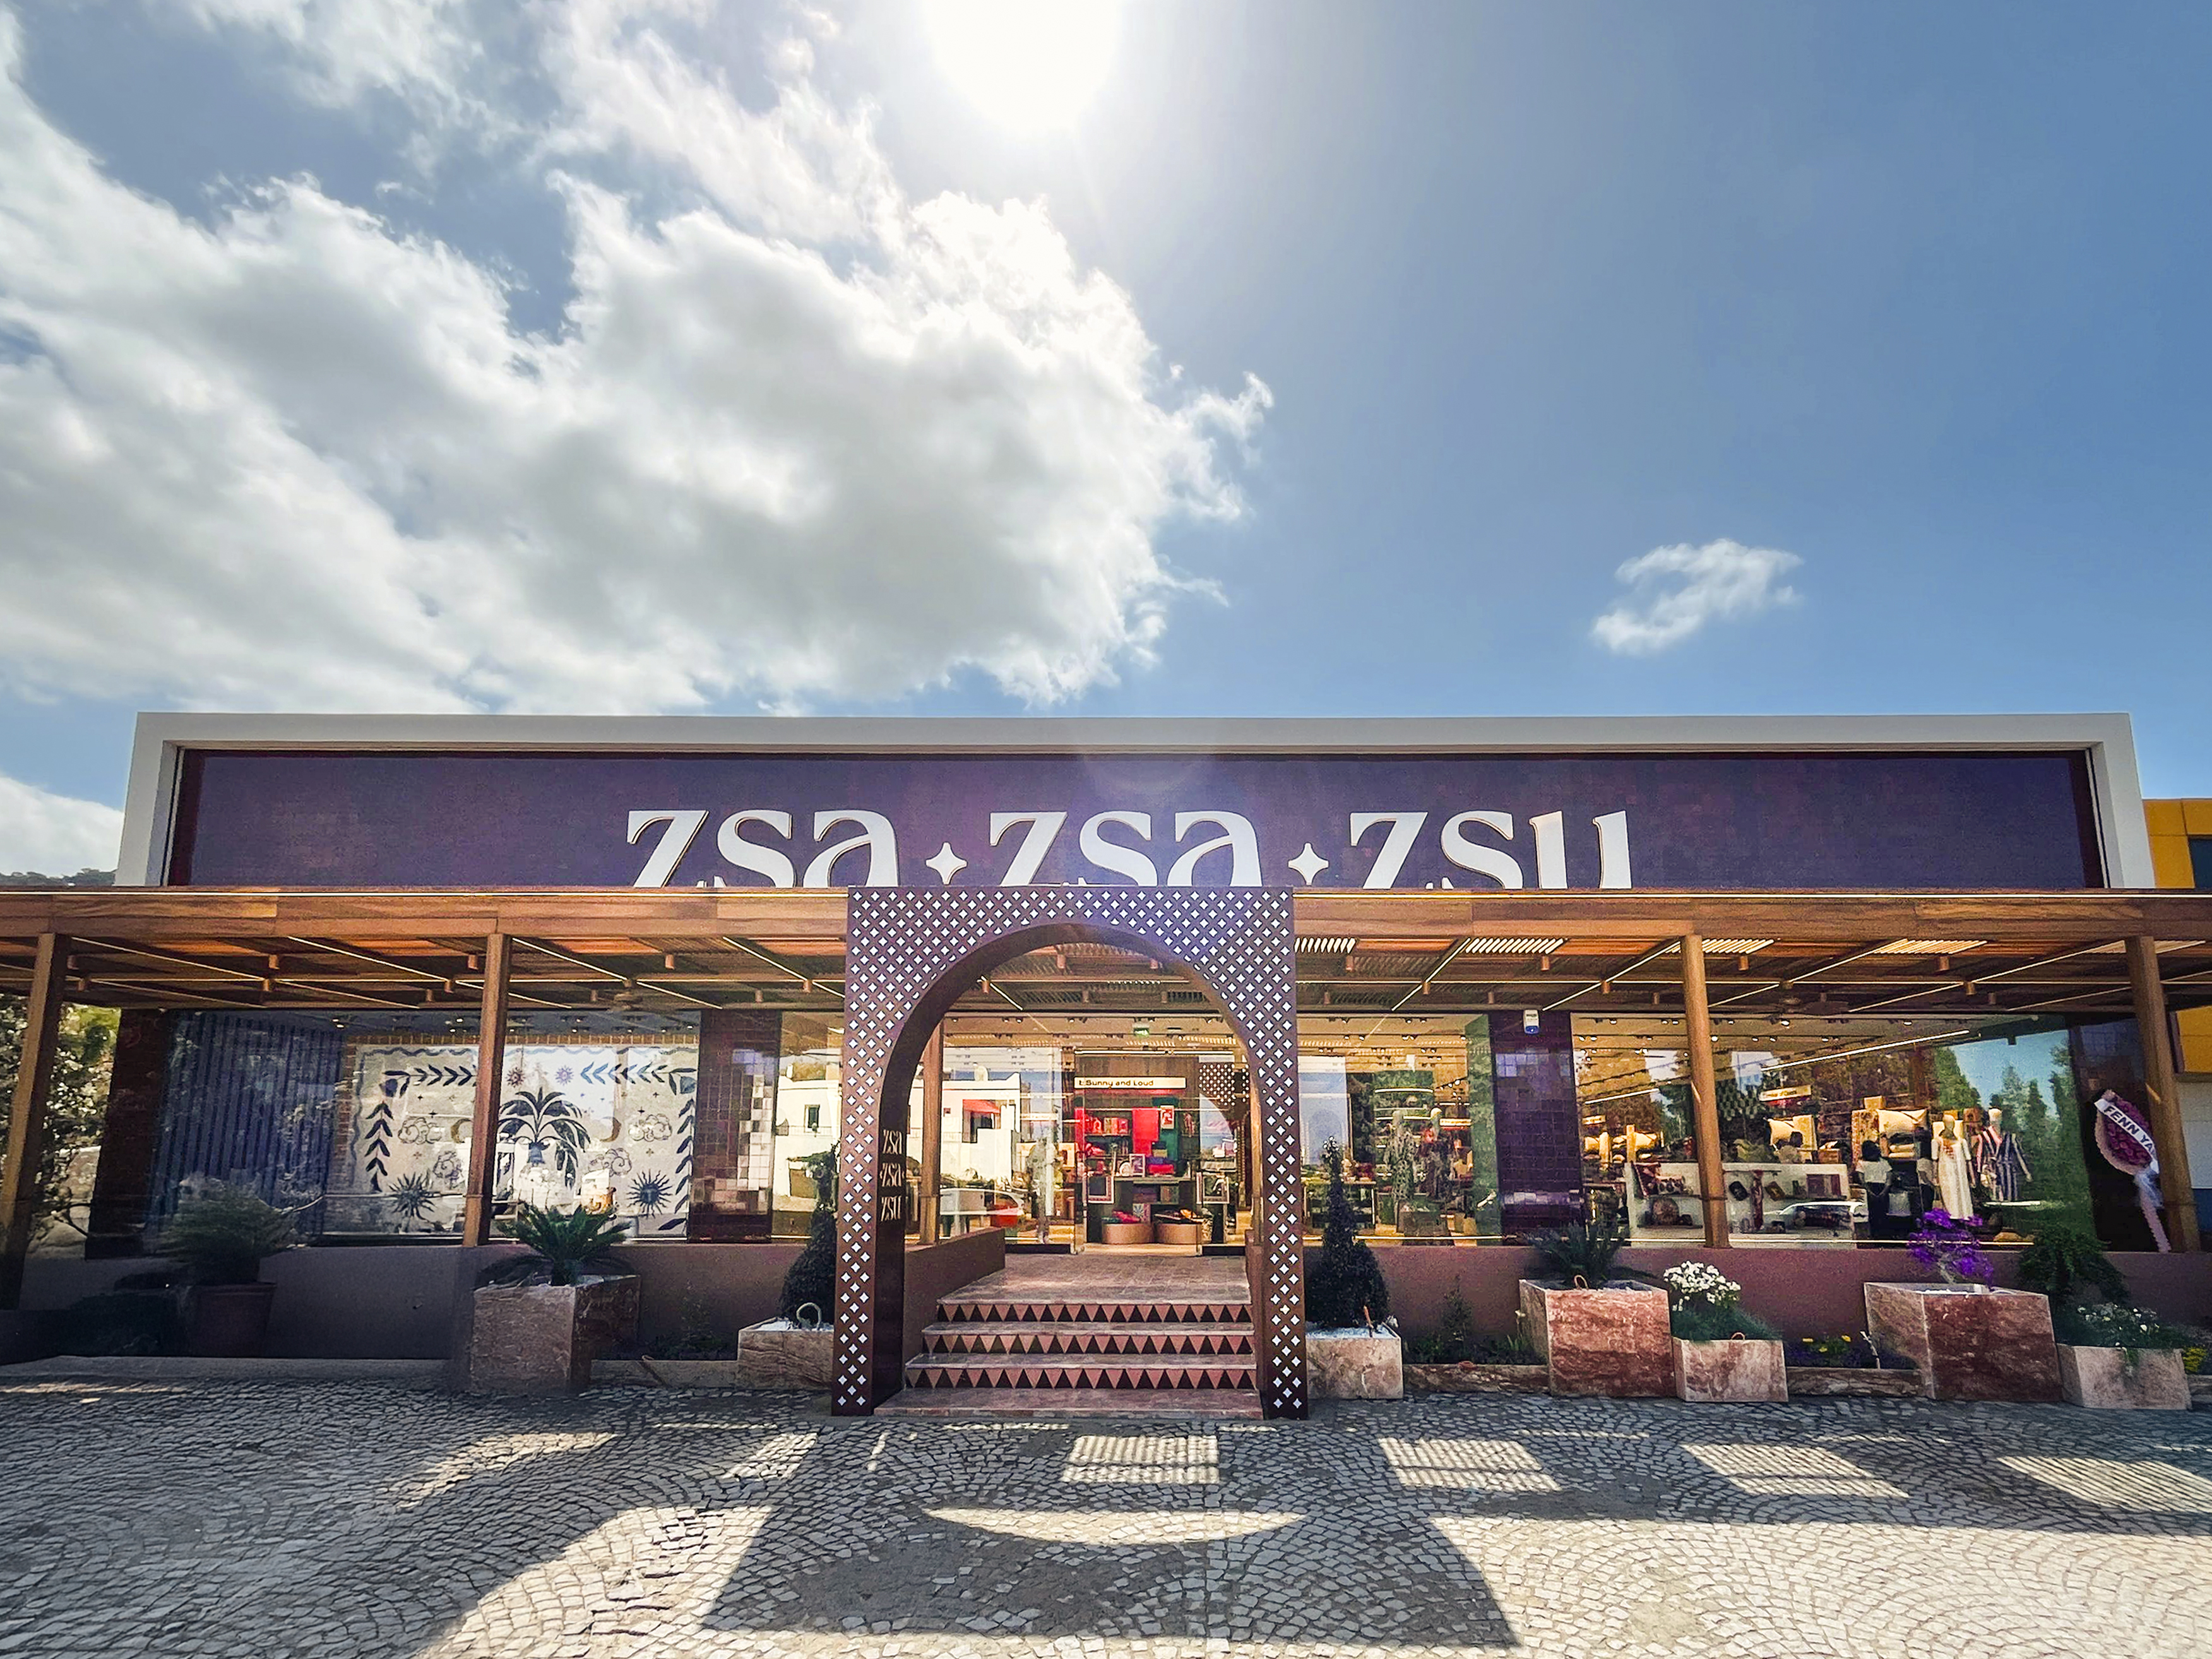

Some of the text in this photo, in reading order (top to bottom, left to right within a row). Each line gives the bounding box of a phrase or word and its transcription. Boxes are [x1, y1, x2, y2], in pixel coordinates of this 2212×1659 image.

[627, 810, 899, 888] zsa
[990, 811, 1263, 887] zsa
[1086, 1079, 1113, 1088] Sunny
[2103, 1106, 2155, 1154] FENN YA
